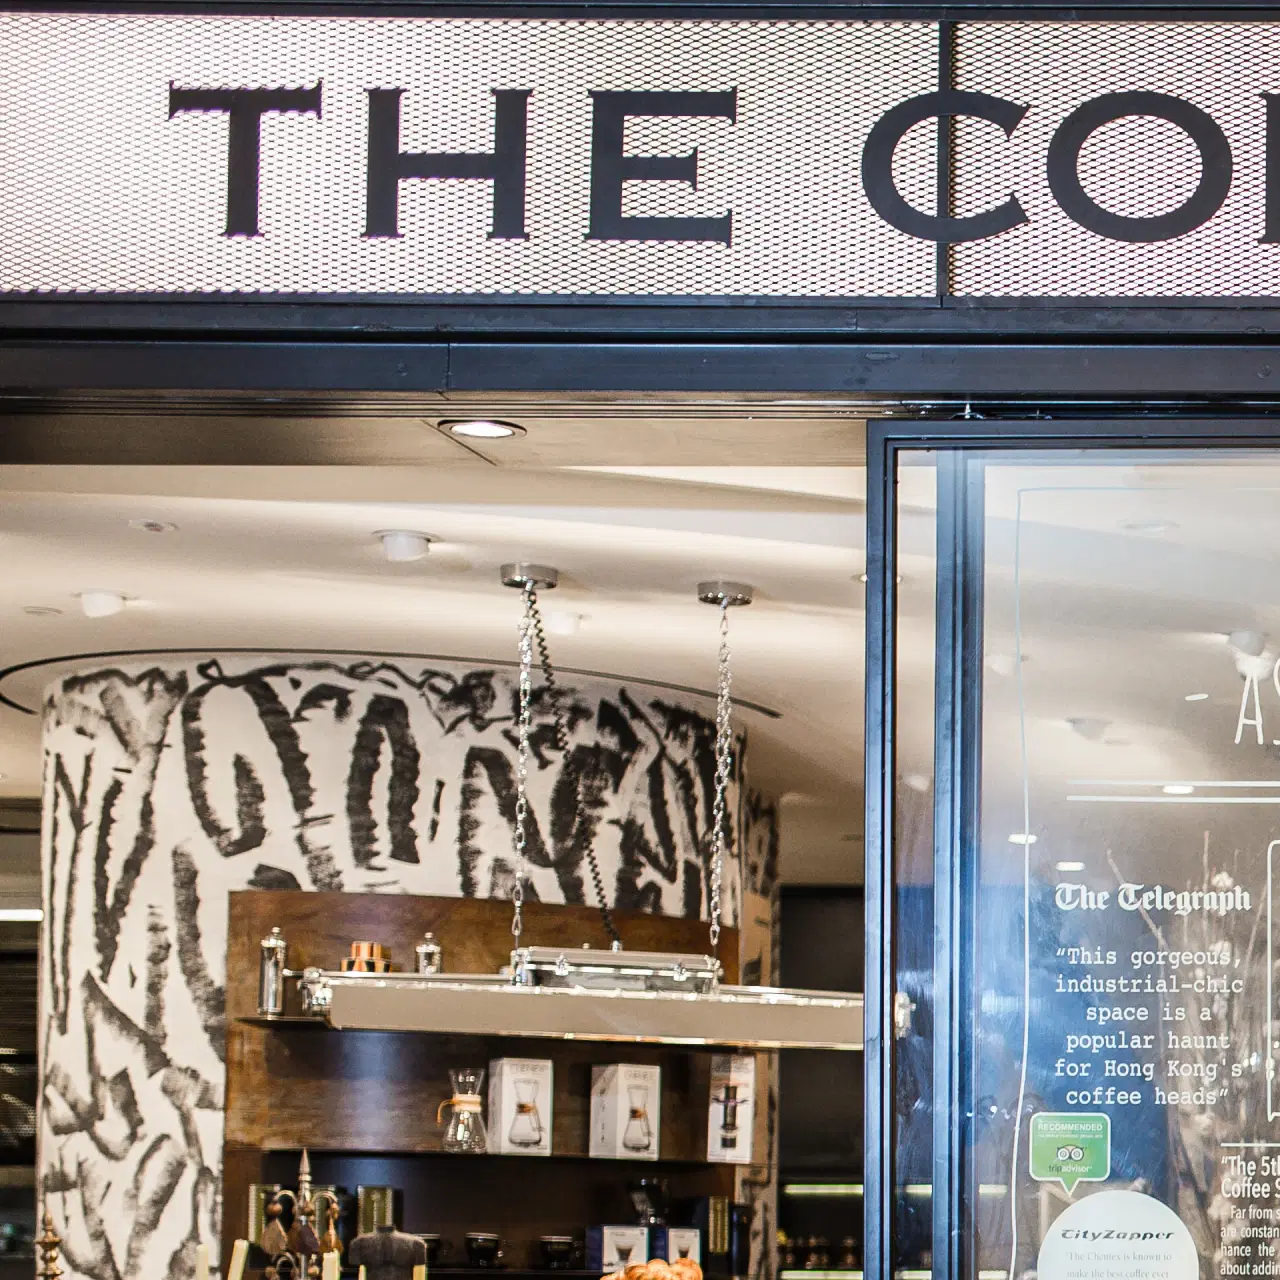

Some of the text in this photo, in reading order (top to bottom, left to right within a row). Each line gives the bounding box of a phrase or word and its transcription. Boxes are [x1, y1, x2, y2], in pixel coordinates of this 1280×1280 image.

[169, 79, 737, 247] THE
[1055, 883, 1252, 916] The Telegraph
[1131, 950, 1241, 969] gorgeous,
[1055, 975, 1243, 993] industrial-chic
[1087, 1003, 1211, 1025] space is a
[1067, 1031, 1230, 1052] popular haunt
[1055, 1059, 1091, 1077] for
[1104, 1060, 1154, 1080] Hong
[1066, 1087, 1141, 1105] coffee
[1038, 1123, 1102, 1131] RECOMMENDED
[1222, 1179, 1271, 1199] Coffee
[1062, 1229, 1174, 1241] CityZapper
